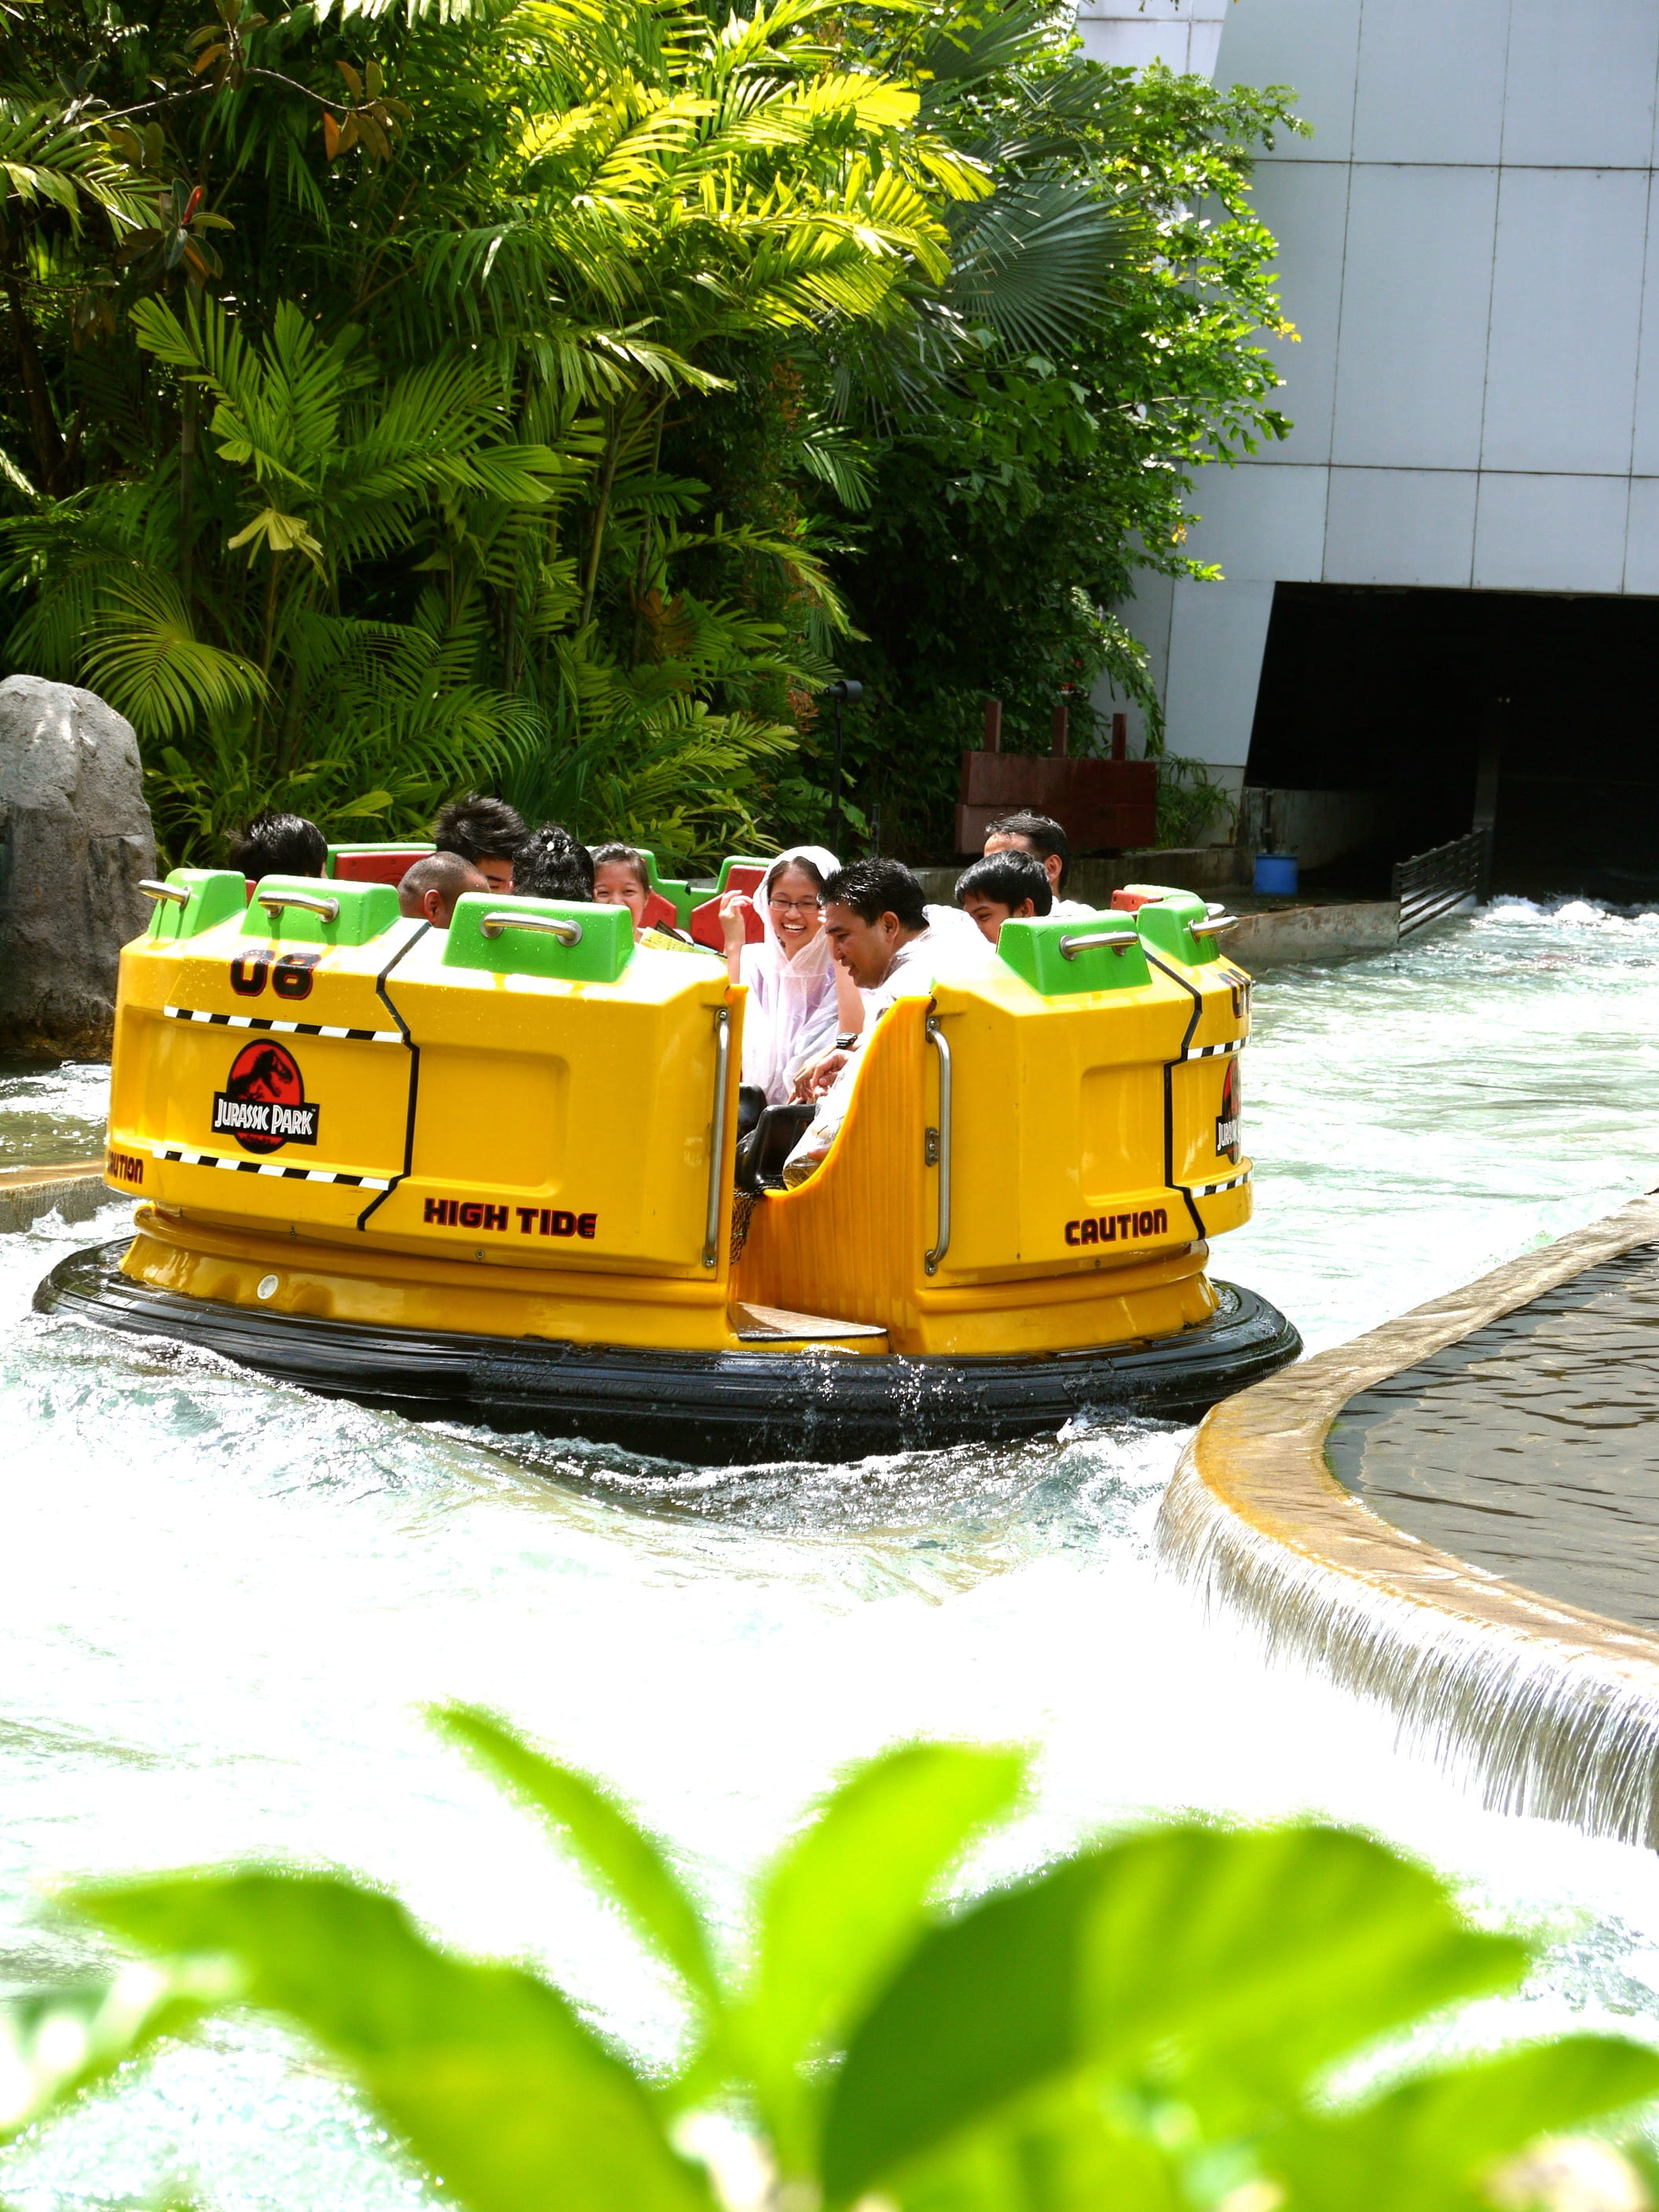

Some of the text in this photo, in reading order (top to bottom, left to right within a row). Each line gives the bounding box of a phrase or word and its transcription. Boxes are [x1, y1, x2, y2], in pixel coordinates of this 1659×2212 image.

[230, 950, 322, 1000] 08
[214, 1098, 313, 1135] JURASSIC PARK
[423, 1197, 598, 1240] HIGH TIDE
[1064, 1207, 1168, 1247] CAUTION
